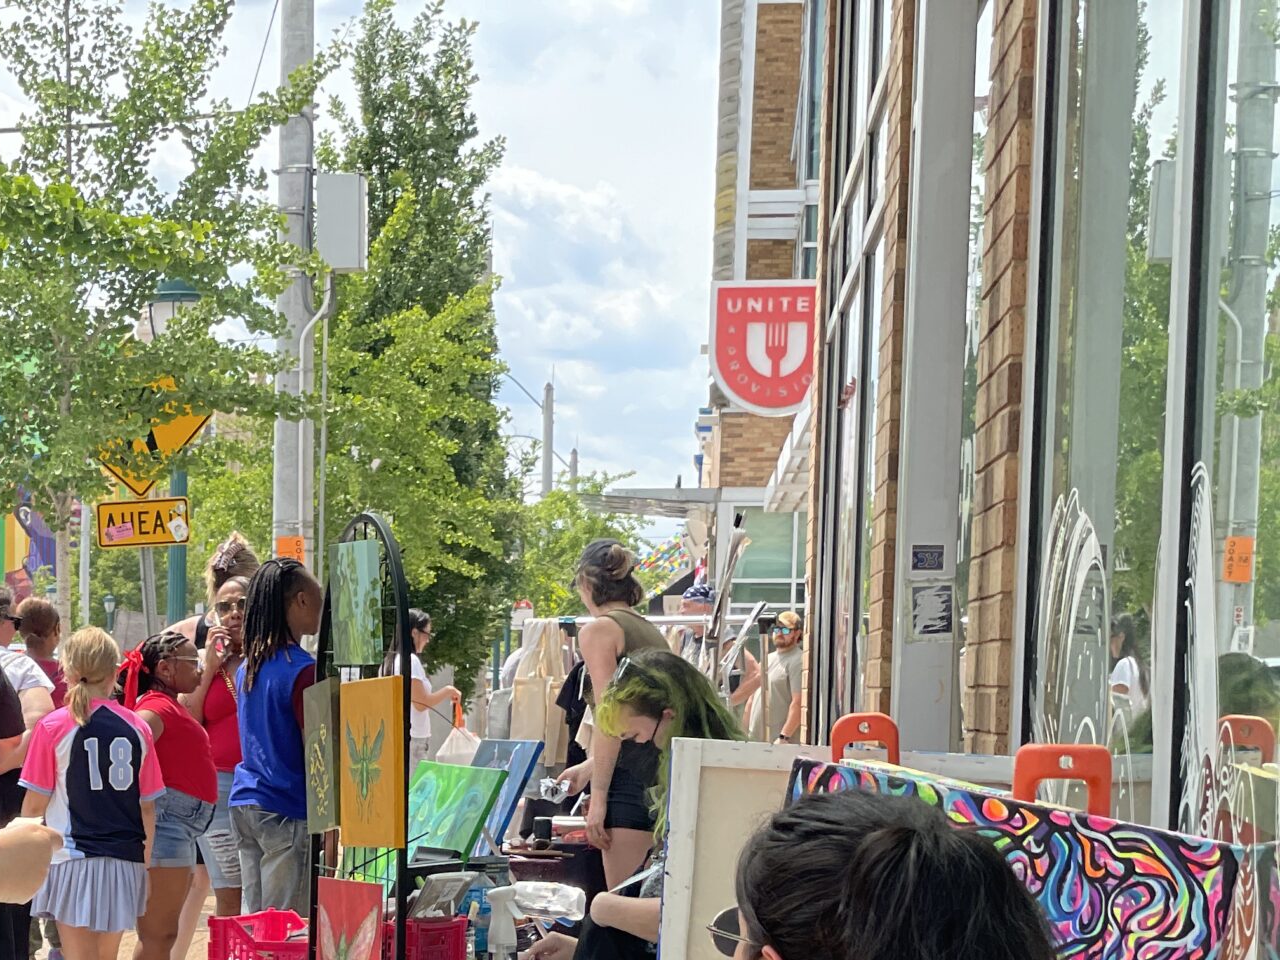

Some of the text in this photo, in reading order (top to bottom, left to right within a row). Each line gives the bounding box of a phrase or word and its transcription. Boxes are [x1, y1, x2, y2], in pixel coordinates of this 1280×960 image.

[726, 296, 810, 313] UNITE
[727, 345, 812, 397] PROVISIO
[83, 736, 134, 791] 18
